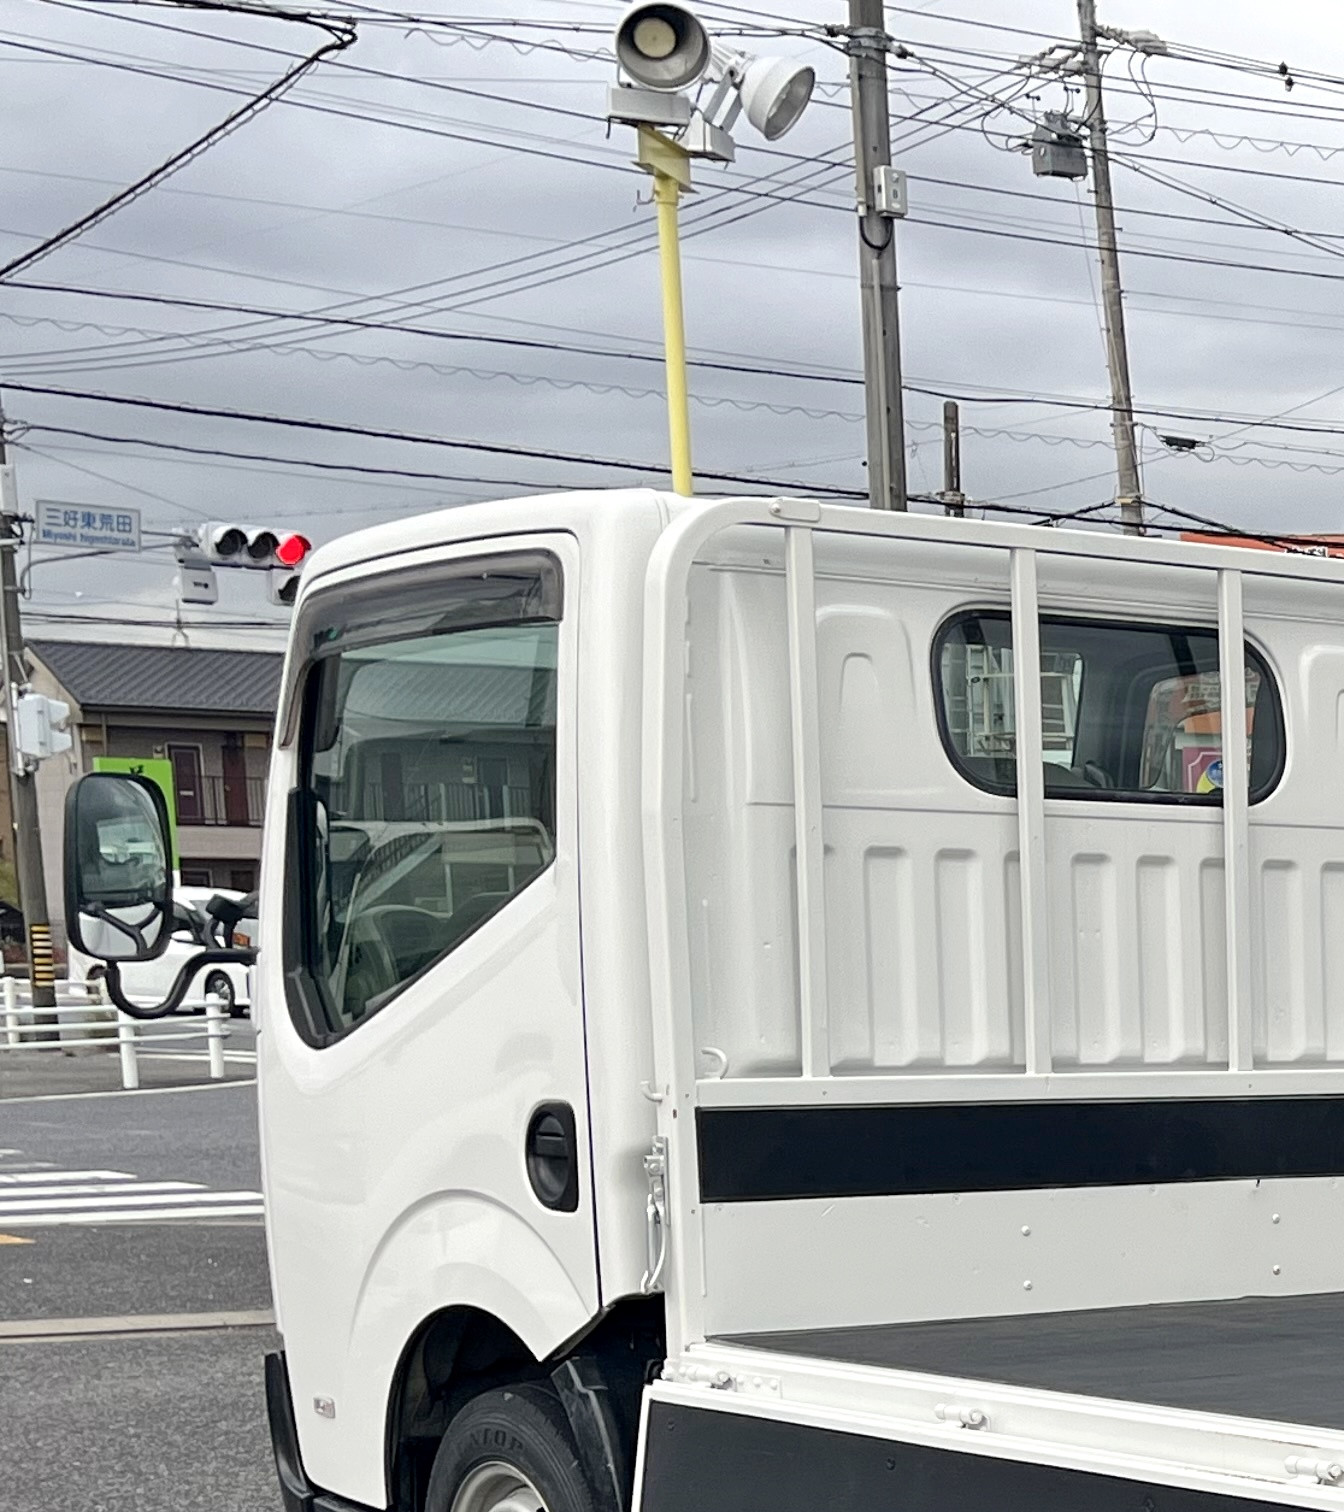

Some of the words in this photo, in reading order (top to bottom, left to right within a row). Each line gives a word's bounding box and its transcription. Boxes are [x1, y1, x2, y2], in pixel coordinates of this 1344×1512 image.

[45, 507, 132, 532] 三好東荒田
